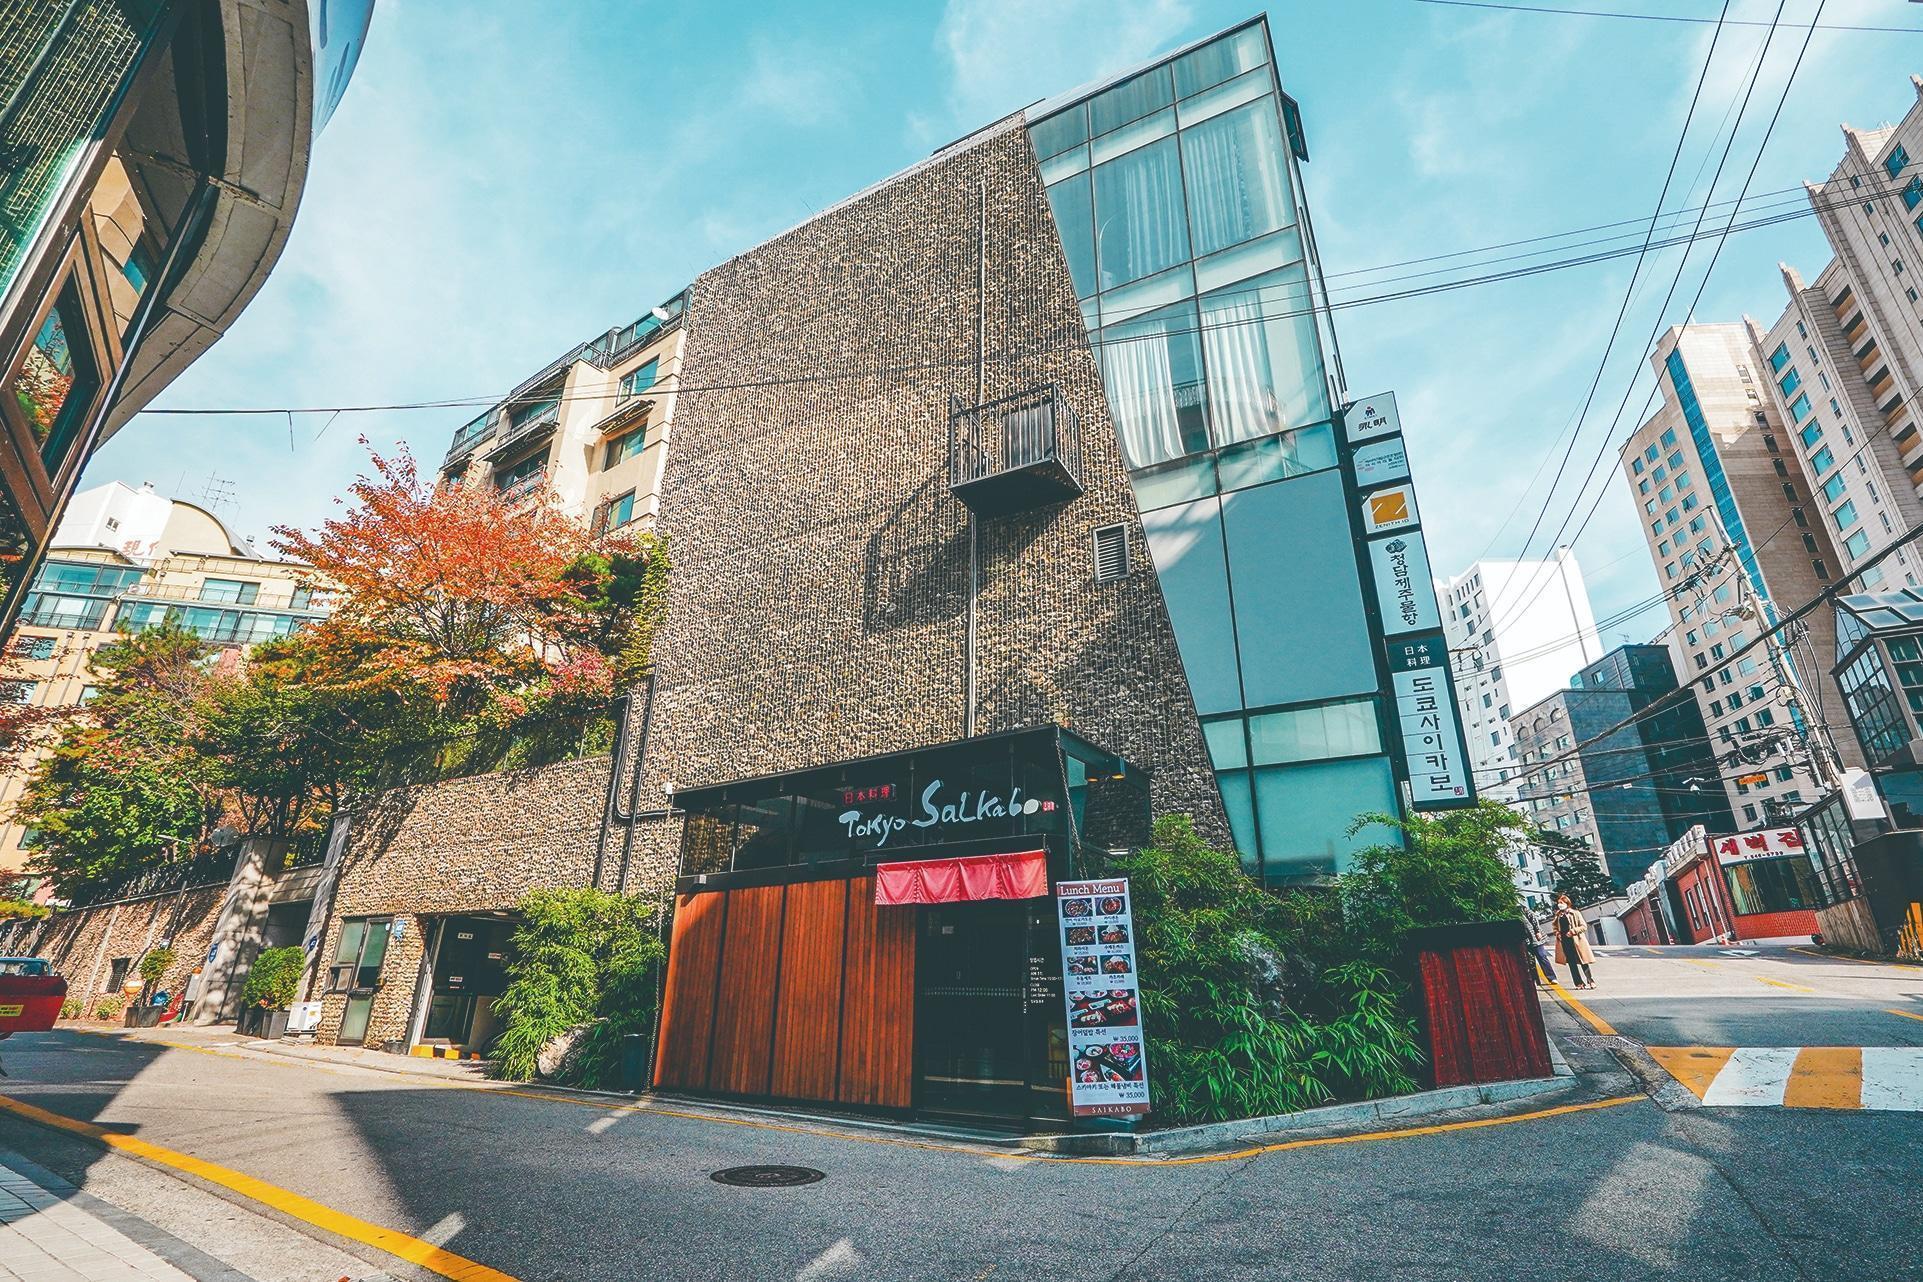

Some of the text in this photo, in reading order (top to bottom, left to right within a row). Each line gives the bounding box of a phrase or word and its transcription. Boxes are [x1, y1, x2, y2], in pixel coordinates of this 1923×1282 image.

[1404, 645, 1428, 656] 日本
[1407, 656, 1431, 667] 料理
[1412, 677, 1453, 793] 도쿄사이카보
[844, 784, 890, 804] 日本料理
[838, 810, 906, 847] Tokyo
[1060, 883, 1120, 896] Lunch Menu
[1092, 1105, 1132, 1114] SAIKABO
